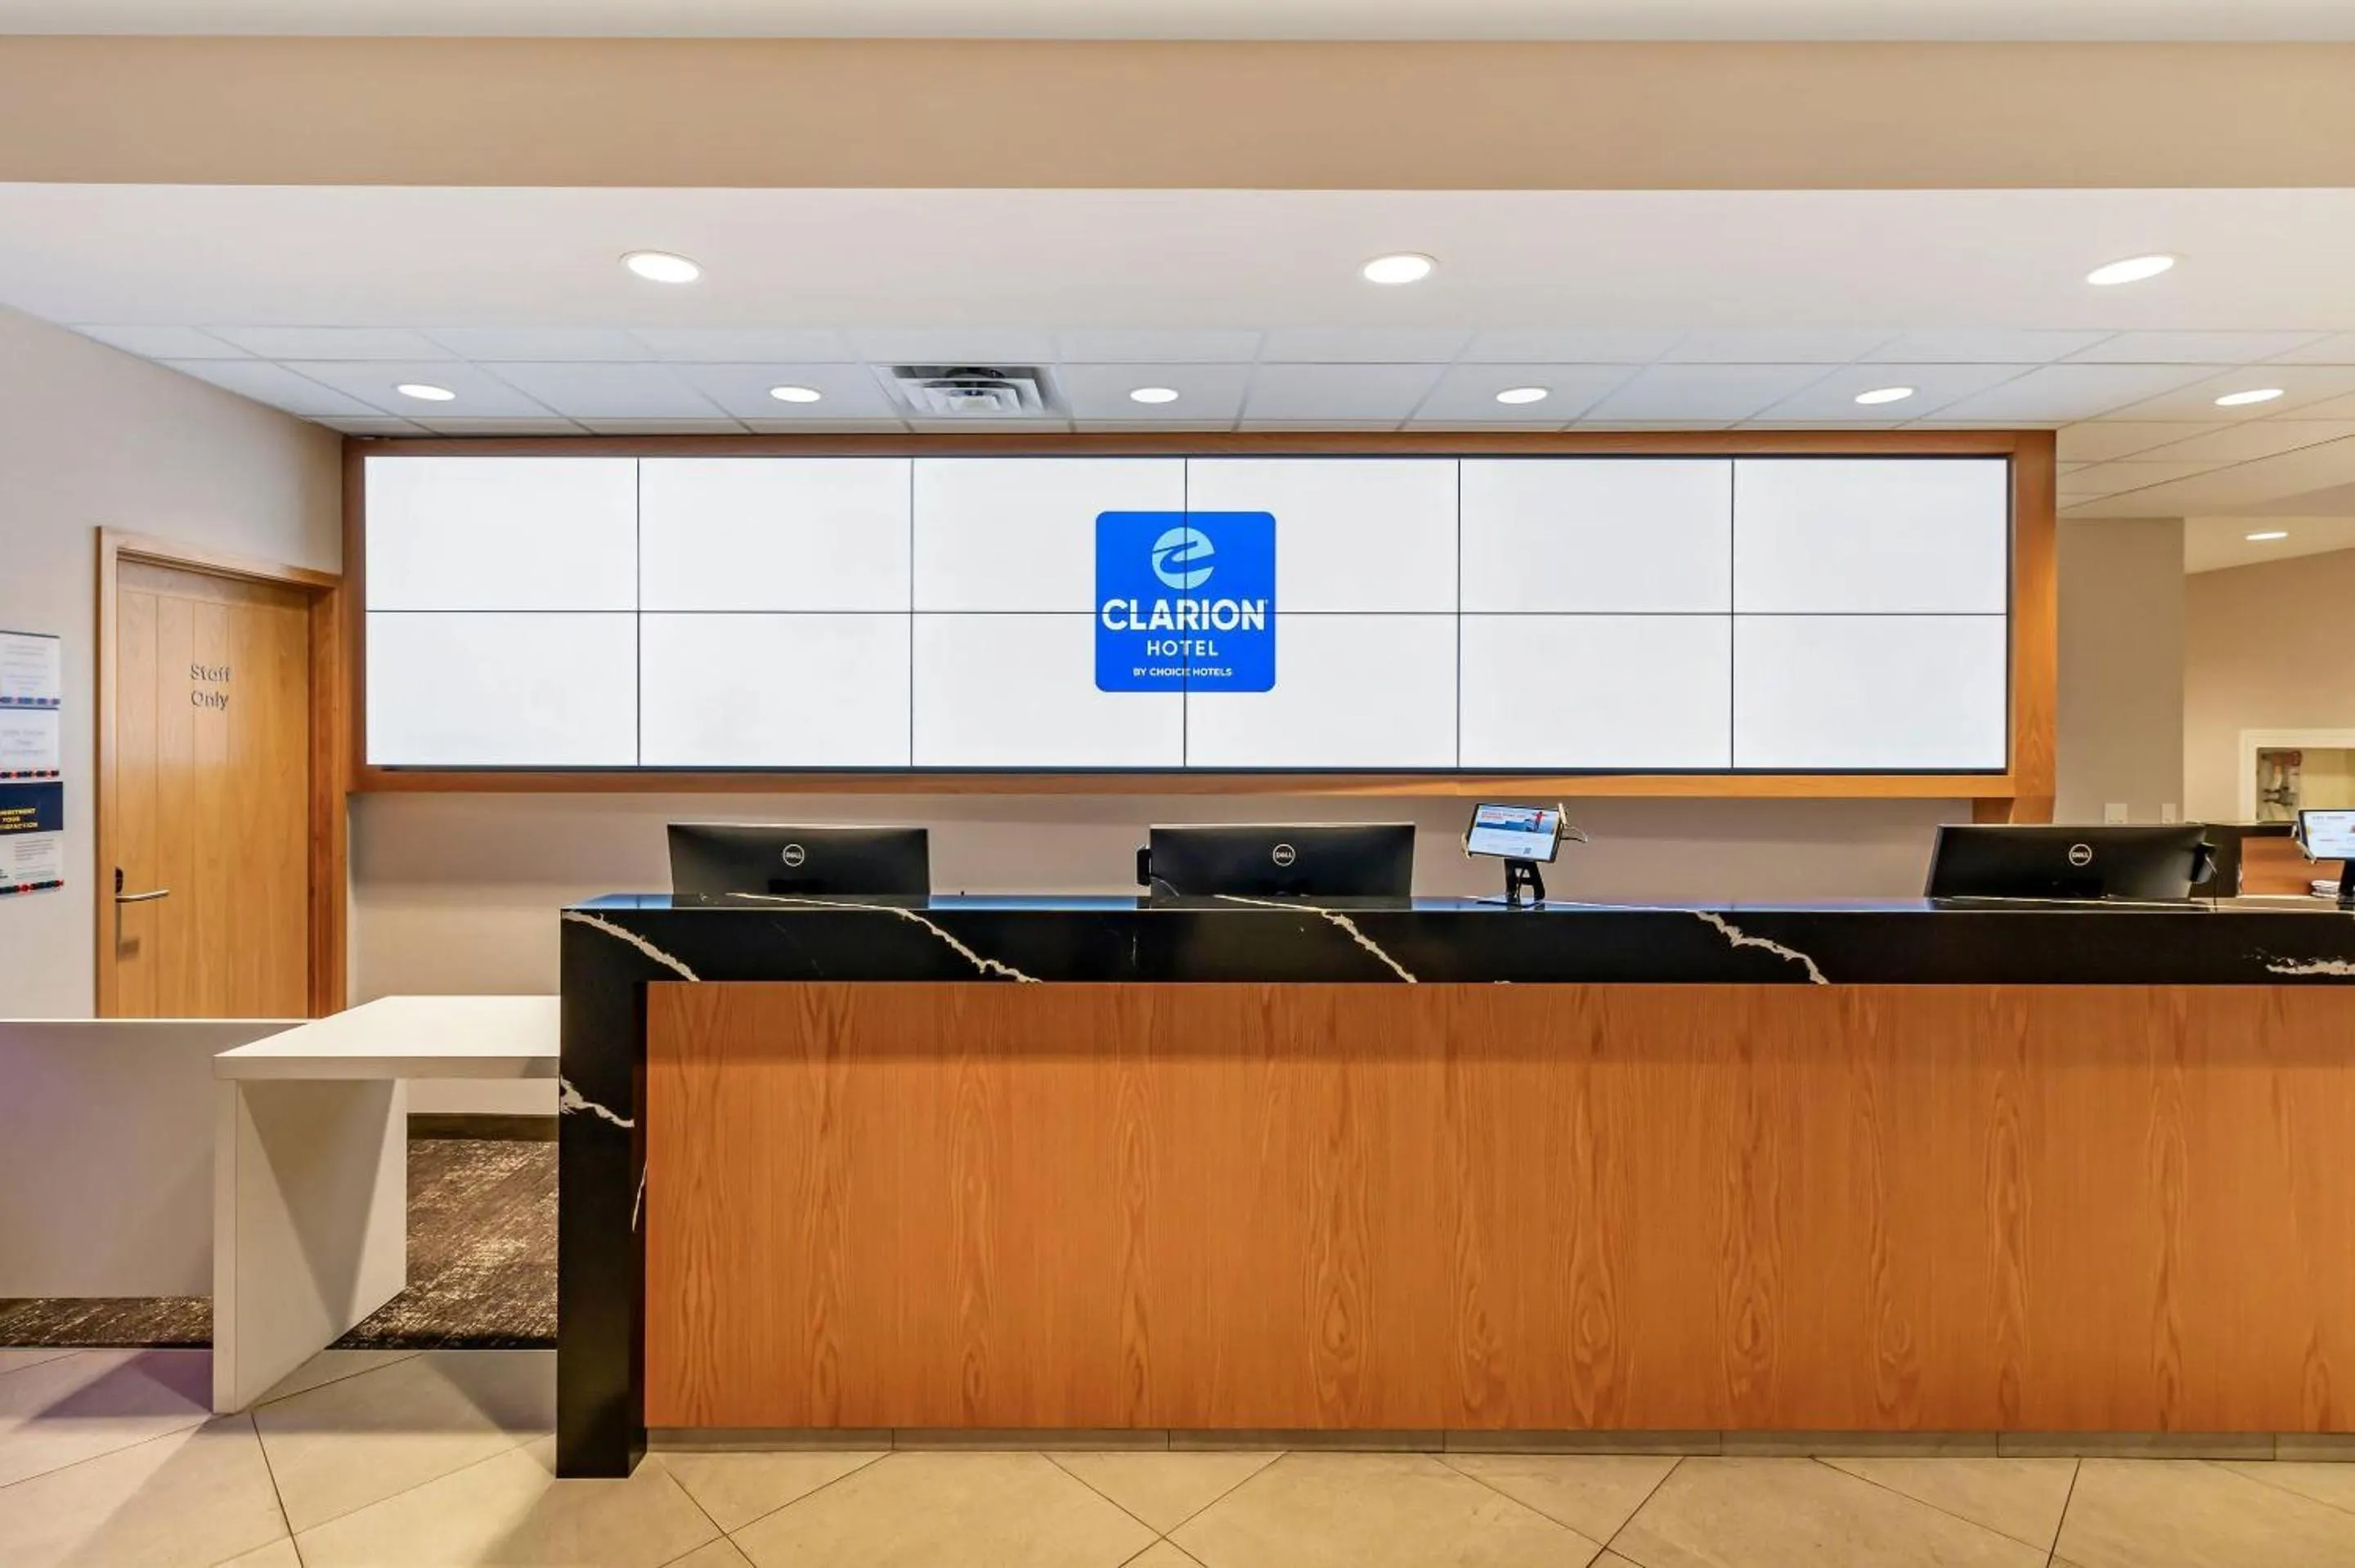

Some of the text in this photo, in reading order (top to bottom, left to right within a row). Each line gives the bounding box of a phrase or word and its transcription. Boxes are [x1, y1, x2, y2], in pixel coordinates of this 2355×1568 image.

[1101, 598, 1265, 631] CLARION
[1146, 639, 1218, 656] HOTEL
[190, 665, 230, 682] Staff
[1133, 666, 1146, 677] BY
[1192, 666, 1232, 677] HOTELS
[191, 690, 229, 710] Only
